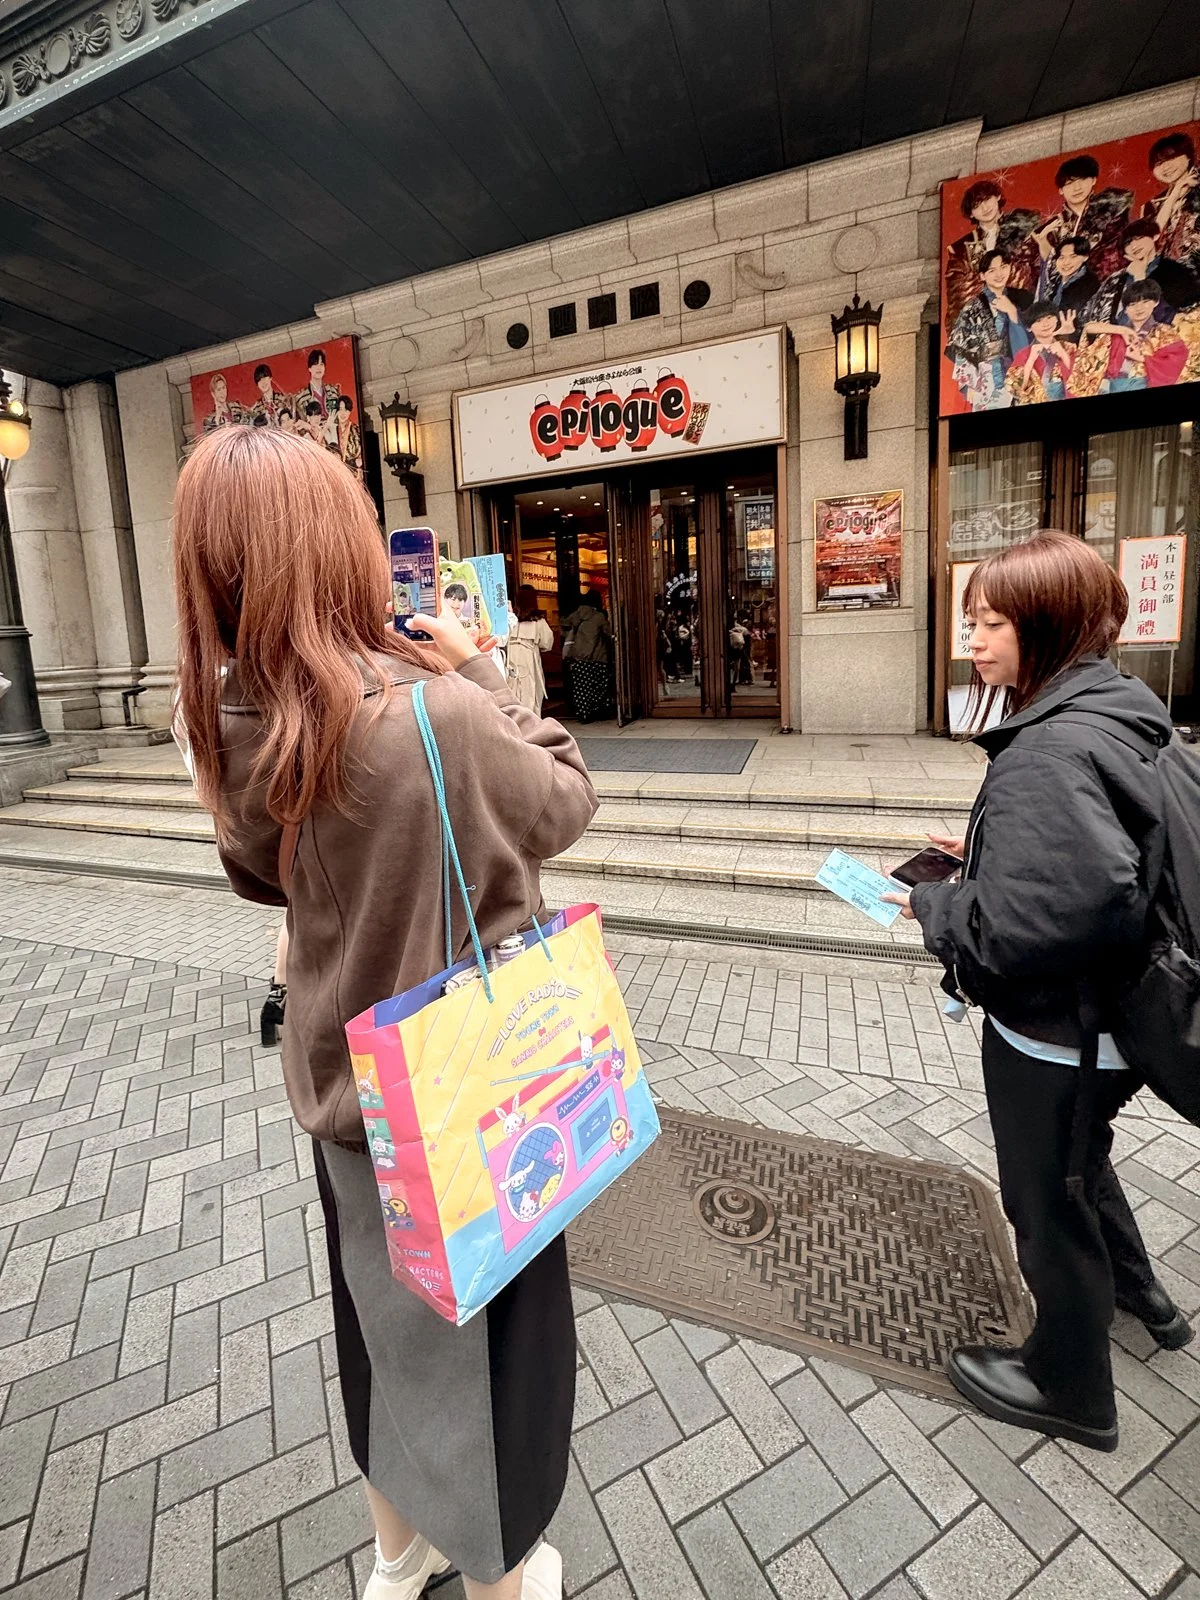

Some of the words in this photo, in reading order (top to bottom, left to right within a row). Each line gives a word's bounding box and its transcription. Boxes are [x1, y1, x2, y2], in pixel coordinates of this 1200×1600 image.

[538, 387, 683, 442] epilogue
[1136, 553, 1159, 636] 満員御禮
[500, 998, 528, 1041] LOVE
[512, 1045, 537, 1068] SANRIO
[712, 1215, 751, 1236] NTT
[403, 1249, 431, 1259] TOWN
